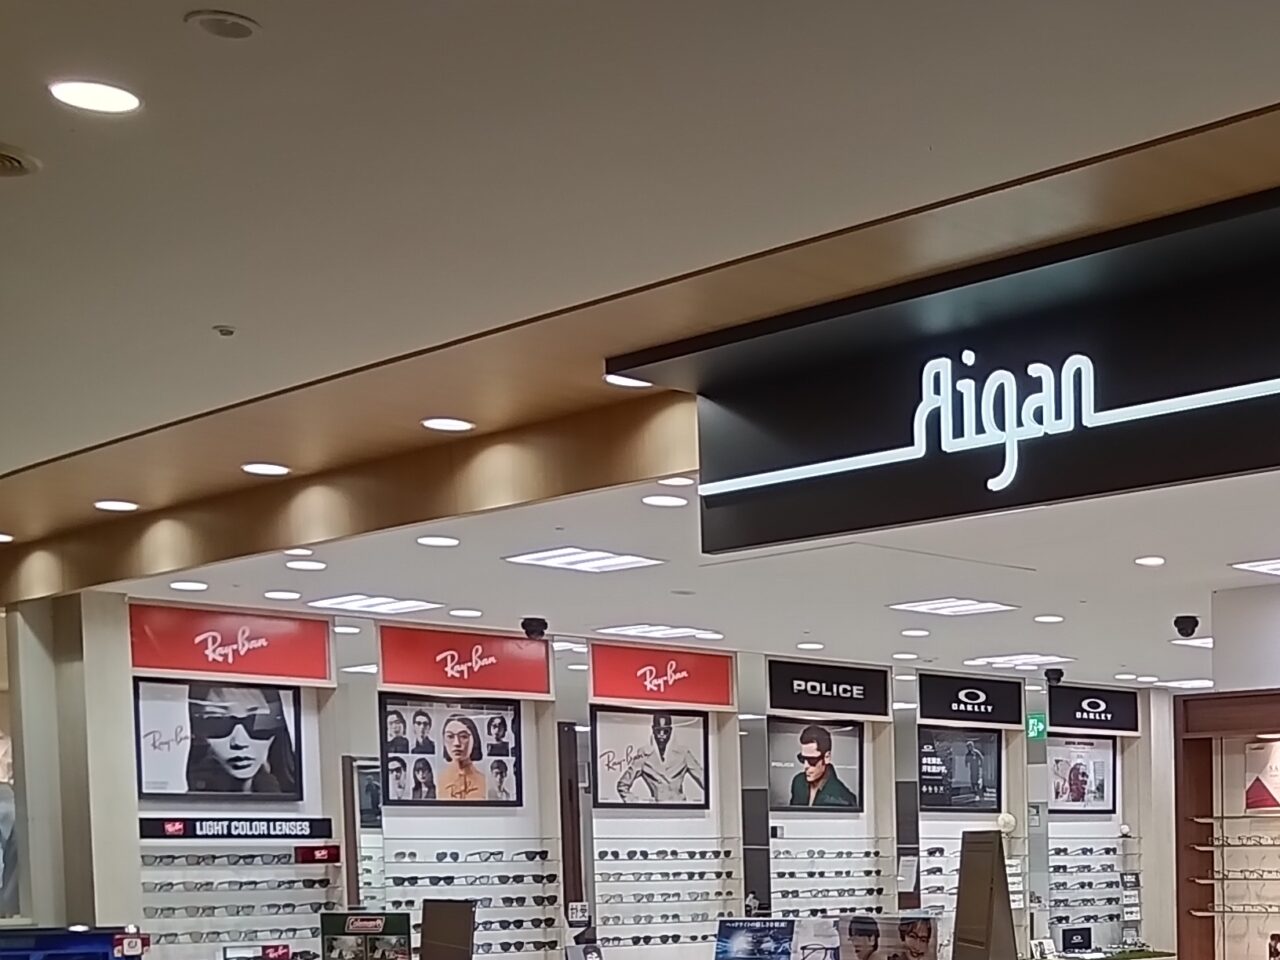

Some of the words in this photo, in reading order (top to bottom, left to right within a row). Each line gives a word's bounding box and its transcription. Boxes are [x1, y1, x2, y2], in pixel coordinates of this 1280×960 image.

[916, 350, 1102, 491] Aigan
[194, 626, 269, 664] Ray-Ban
[435, 645, 498, 679] Ray-Ban
[636, 661, 689, 692] Ray-Ban
[793, 680, 865, 698] POLICE
[951, 702, 994, 713] OAKLEY
[1075, 711, 1113, 721] OAKLEY
[195, 820, 229, 836] LIGHT
[230, 821, 268, 836] COLOR
[269, 821, 311, 836] LENSES
